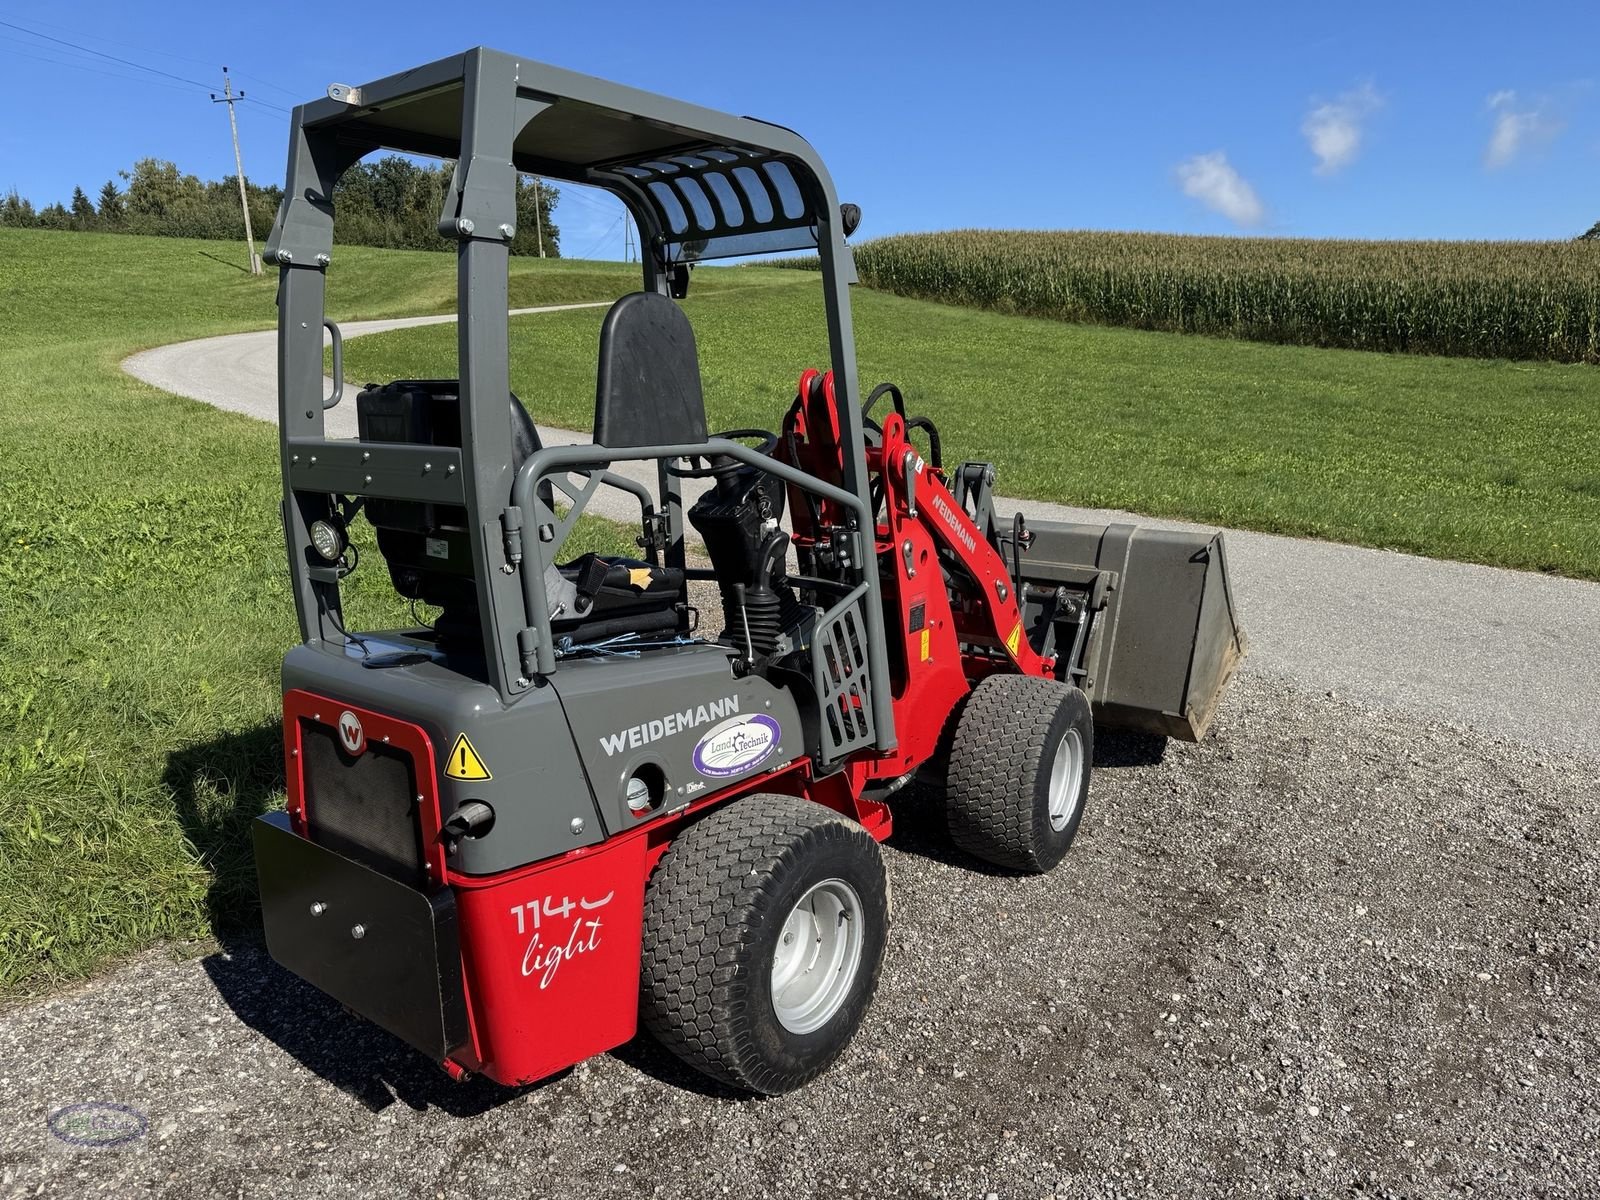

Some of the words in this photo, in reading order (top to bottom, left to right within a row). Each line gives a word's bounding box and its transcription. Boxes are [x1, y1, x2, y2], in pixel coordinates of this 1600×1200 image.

[341, 722, 360, 745] W
[600, 694, 739, 757] WEIDEMANN
[711, 737, 732, 753] Land
[739, 732, 769, 751] Technik
[521, 916, 604, 989] light
